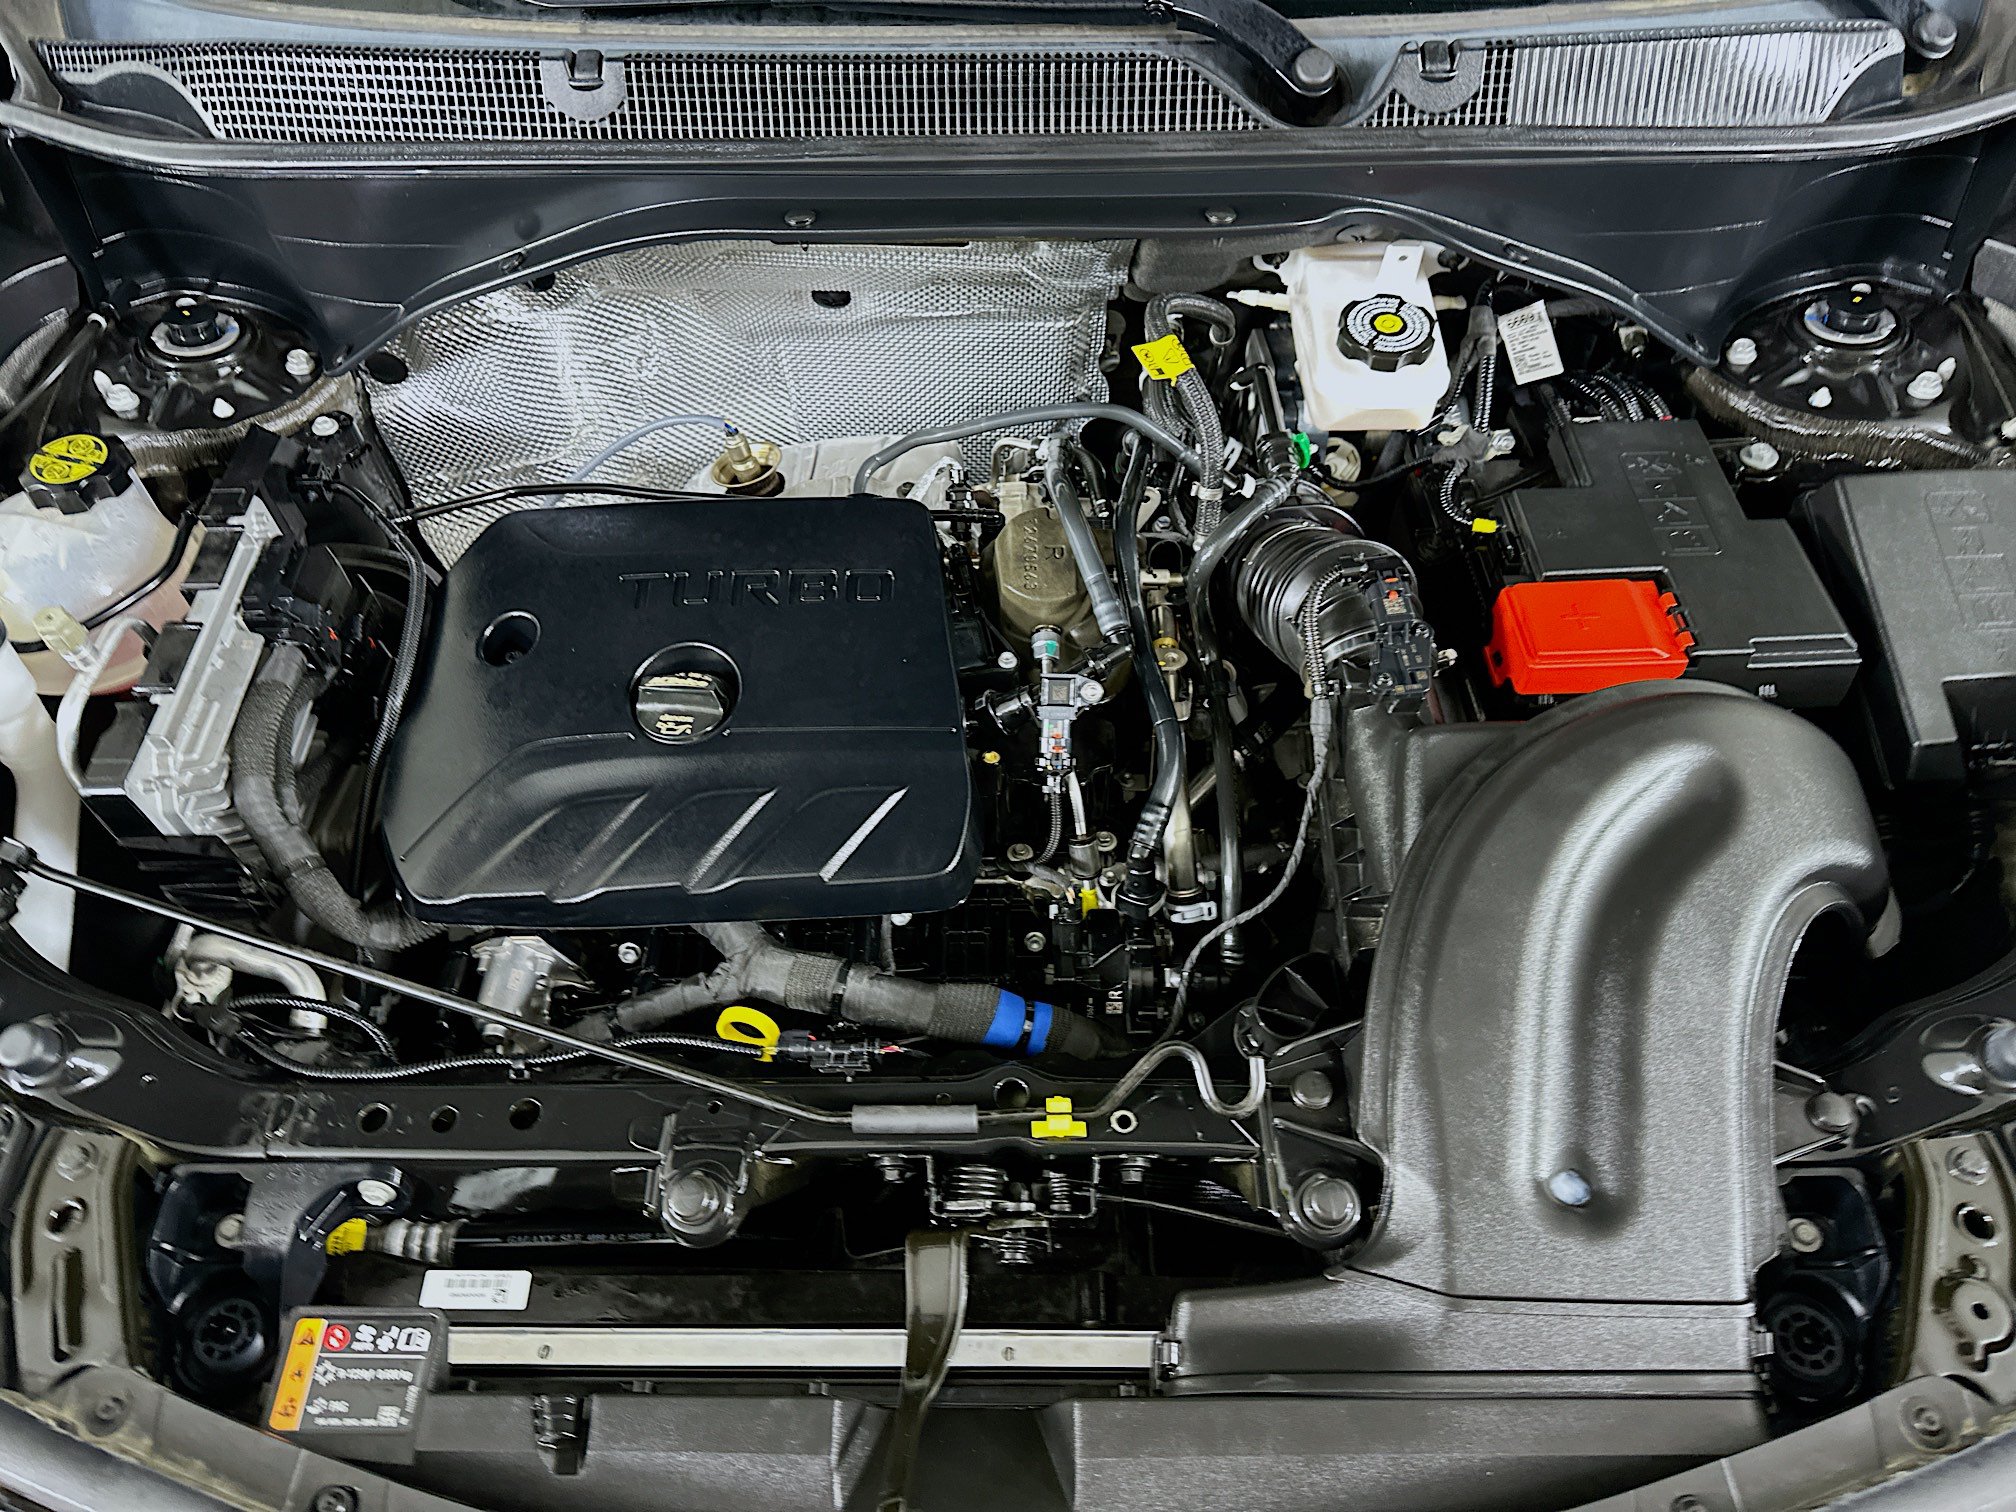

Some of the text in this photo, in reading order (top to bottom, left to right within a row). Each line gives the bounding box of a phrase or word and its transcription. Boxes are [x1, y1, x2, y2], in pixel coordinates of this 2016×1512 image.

[1044, 545, 1066, 560] R
[618, 569, 895, 609] TURBO
[1107, 990, 1123, 999] R
